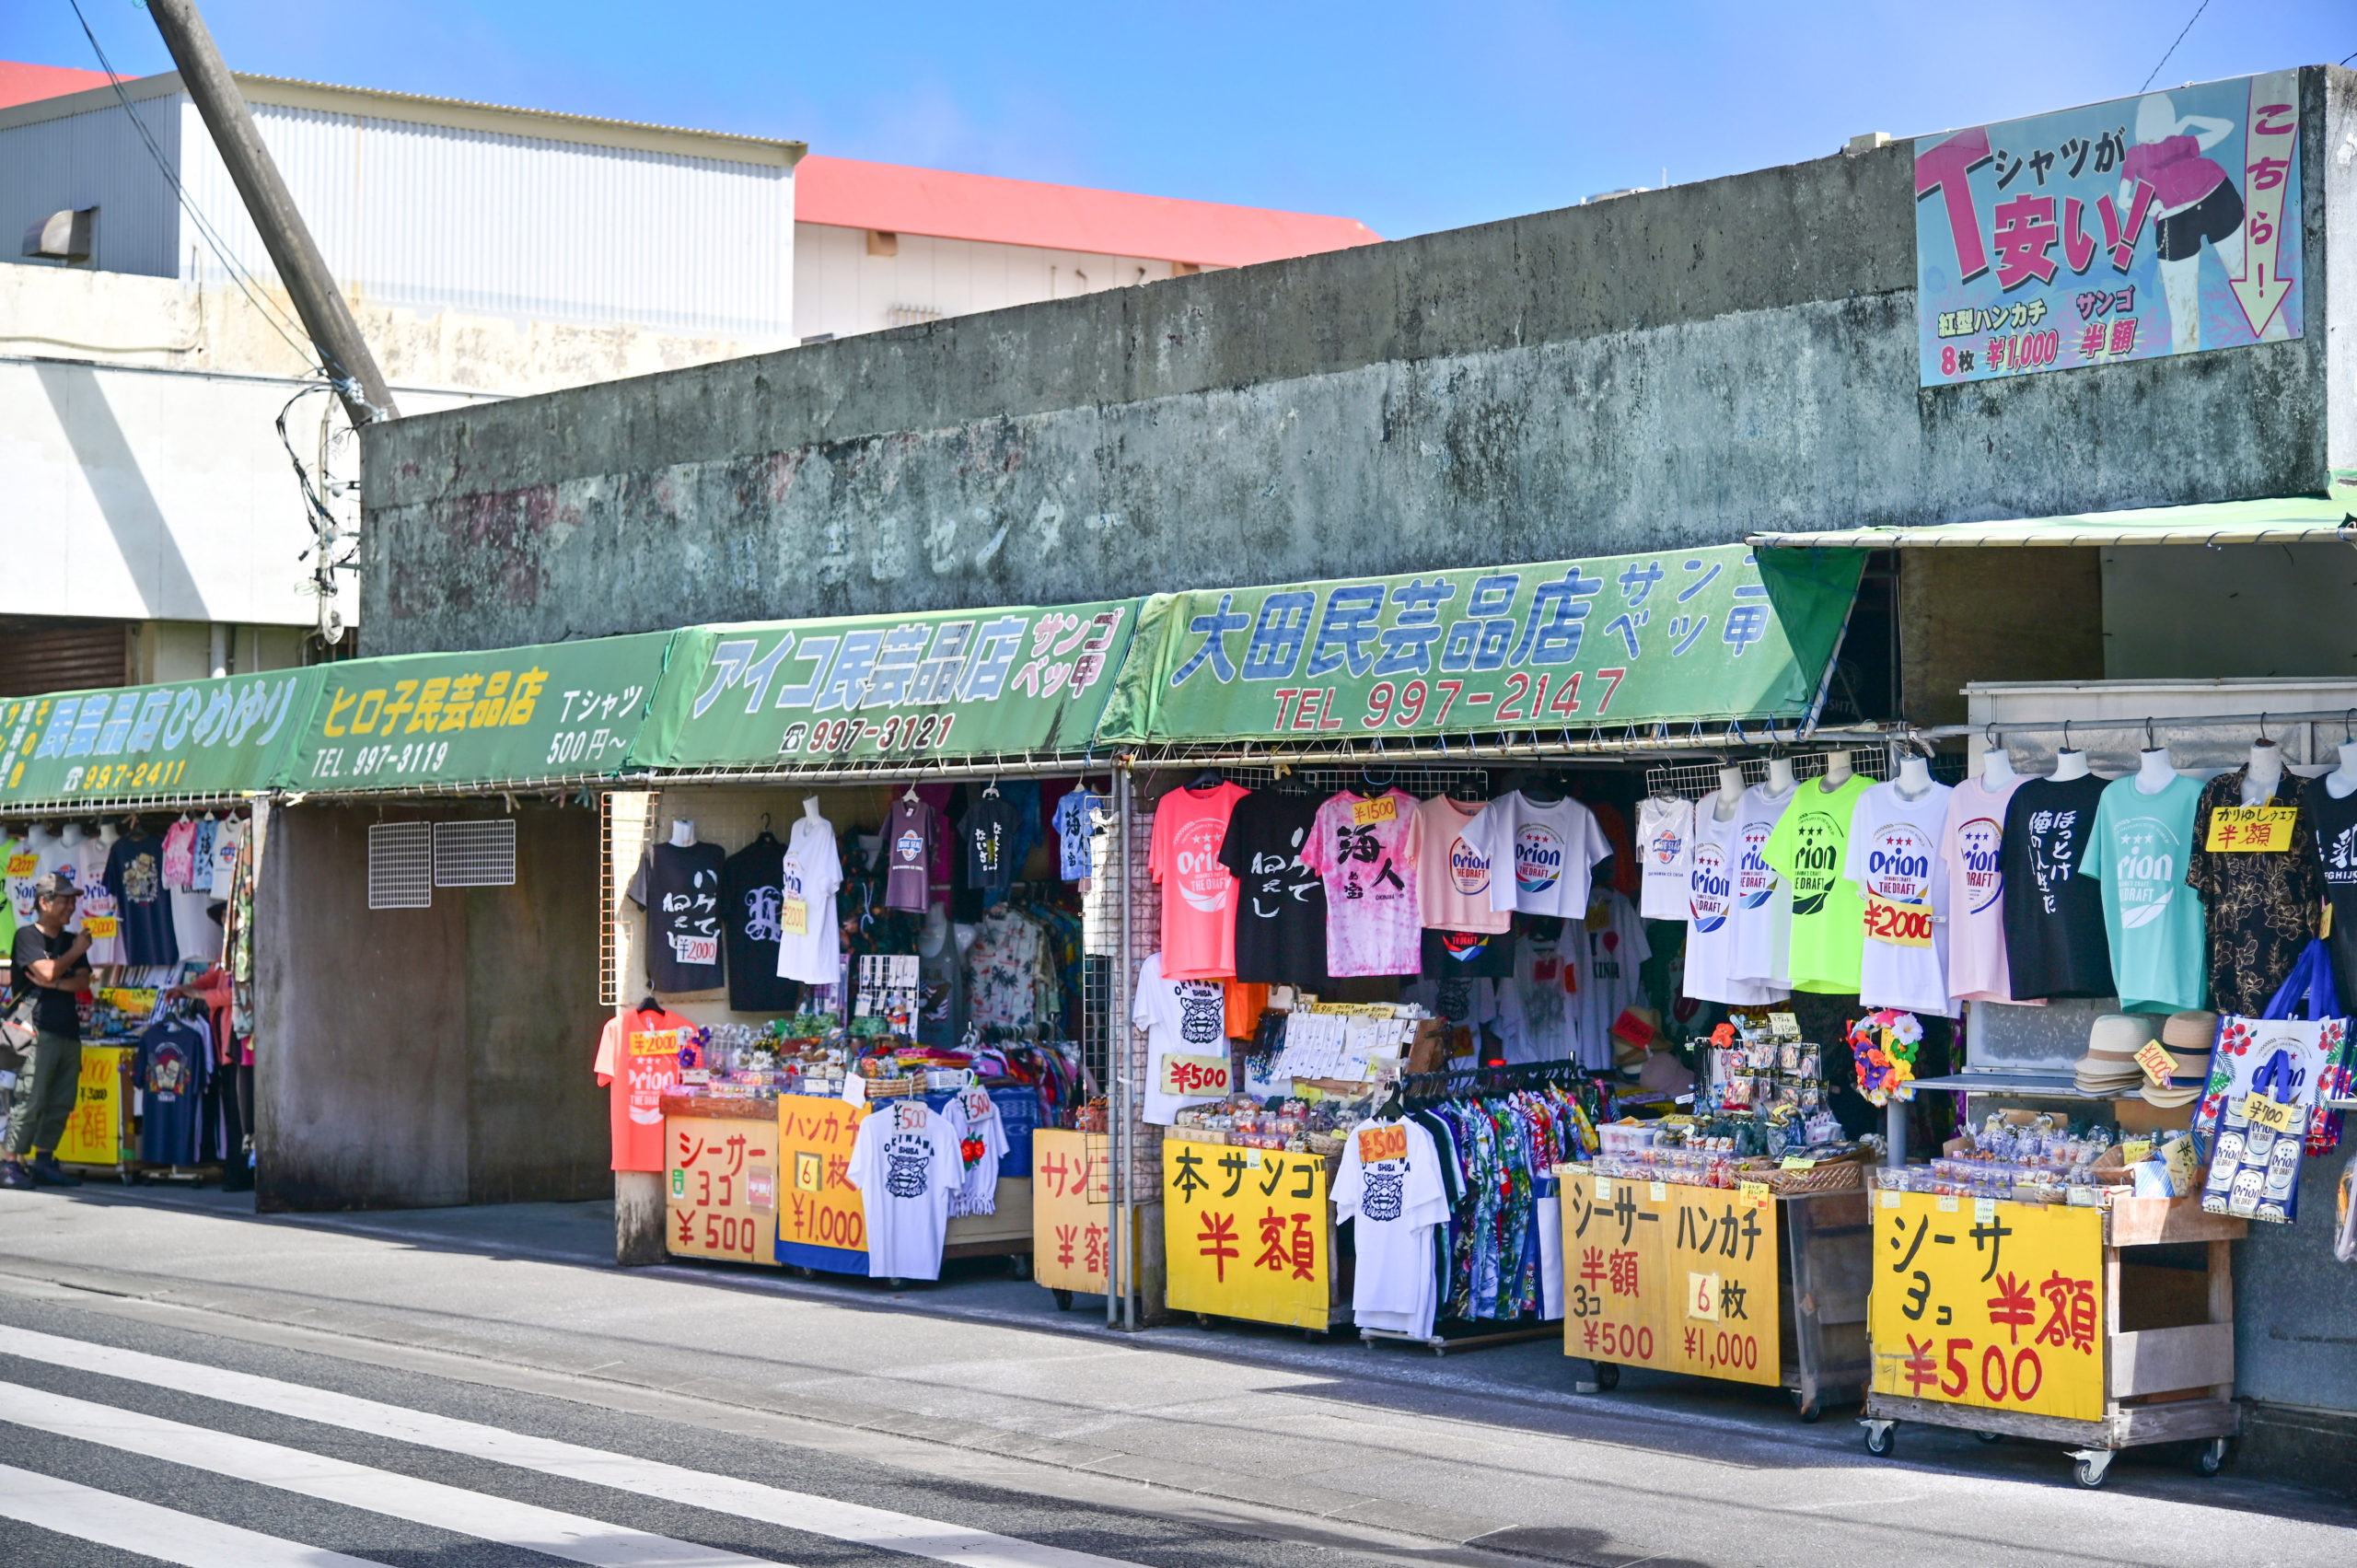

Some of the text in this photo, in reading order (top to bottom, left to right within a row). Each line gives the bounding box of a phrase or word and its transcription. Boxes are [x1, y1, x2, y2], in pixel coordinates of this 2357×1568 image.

[1992, 180, 2155, 293] 安い!
[1937, 299, 2047, 339] 紅型ハンカチ
[2076, 285, 2136, 319] サンゴ
[1985, 329, 2059, 371] ¥1,000
[2080, 317, 2138, 358] 半額
[1941, 345, 1976, 377] 8枚
[1031, 605, 1126, 659] サンゴ
[1169, 565, 1606, 687] 大田民芸品店
[693, 614, 1029, 720] アイコ民芸品店
[34, 677, 297, 761] 民芸品店ひめゆり
[324, 665, 551, 738] ヒロ子民芸品店
[560, 683, 645, 723] Tシャツ
[1273, 666, 1627, 732] TEL 997-2147
[807, 712, 957, 754] 997-3121
[83, 760, 186, 790] 997-2411
[352, 740, 449, 778] 997-3119
[1794, 838, 1837, 871] rion
[2050, 810, 2077, 881] ほっとけ
[2218, 822, 2273, 850] 半額
[1177, 842, 1231, 875] Orio
[1869, 847, 1929, 878] Orion
[1964, 842, 2001, 873] rion
[2118, 845, 2173, 882] rion
[1879, 882, 1916, 896] THE DRAFT
[1864, 899, 1933, 940] ¥2000
[1174, 979, 1220, 996] OKINAW
[1170, 1062, 1227, 1094] ¥500
[894, 1105, 928, 1132] ¥500
[960, 1093, 992, 1121] ¥500
[679, 1132, 767, 1177] シーサー
[884, 1133, 935, 1157] OKINAWA
[898, 1144, 919, 1156] SHISA
[1359, 1129, 1407, 1163] ¥500
[1172, 1146, 1326, 1204] 本サンゴ
[676, 1208, 756, 1254] ¥500
[1573, 1181, 1762, 1261] シーサー ハンカチ
[1197, 1206, 1316, 1283] 半額
[1890, 1214, 2013, 1283] シーサ
[1580, 1245, 1640, 1298] 半額
[1987, 1269, 2097, 1355] 半額
[1583, 1318, 1655, 1361] ¥500
[1684, 1326, 1758, 1371] ¥1,000
[1904, 1332, 2043, 1403] ¥500
